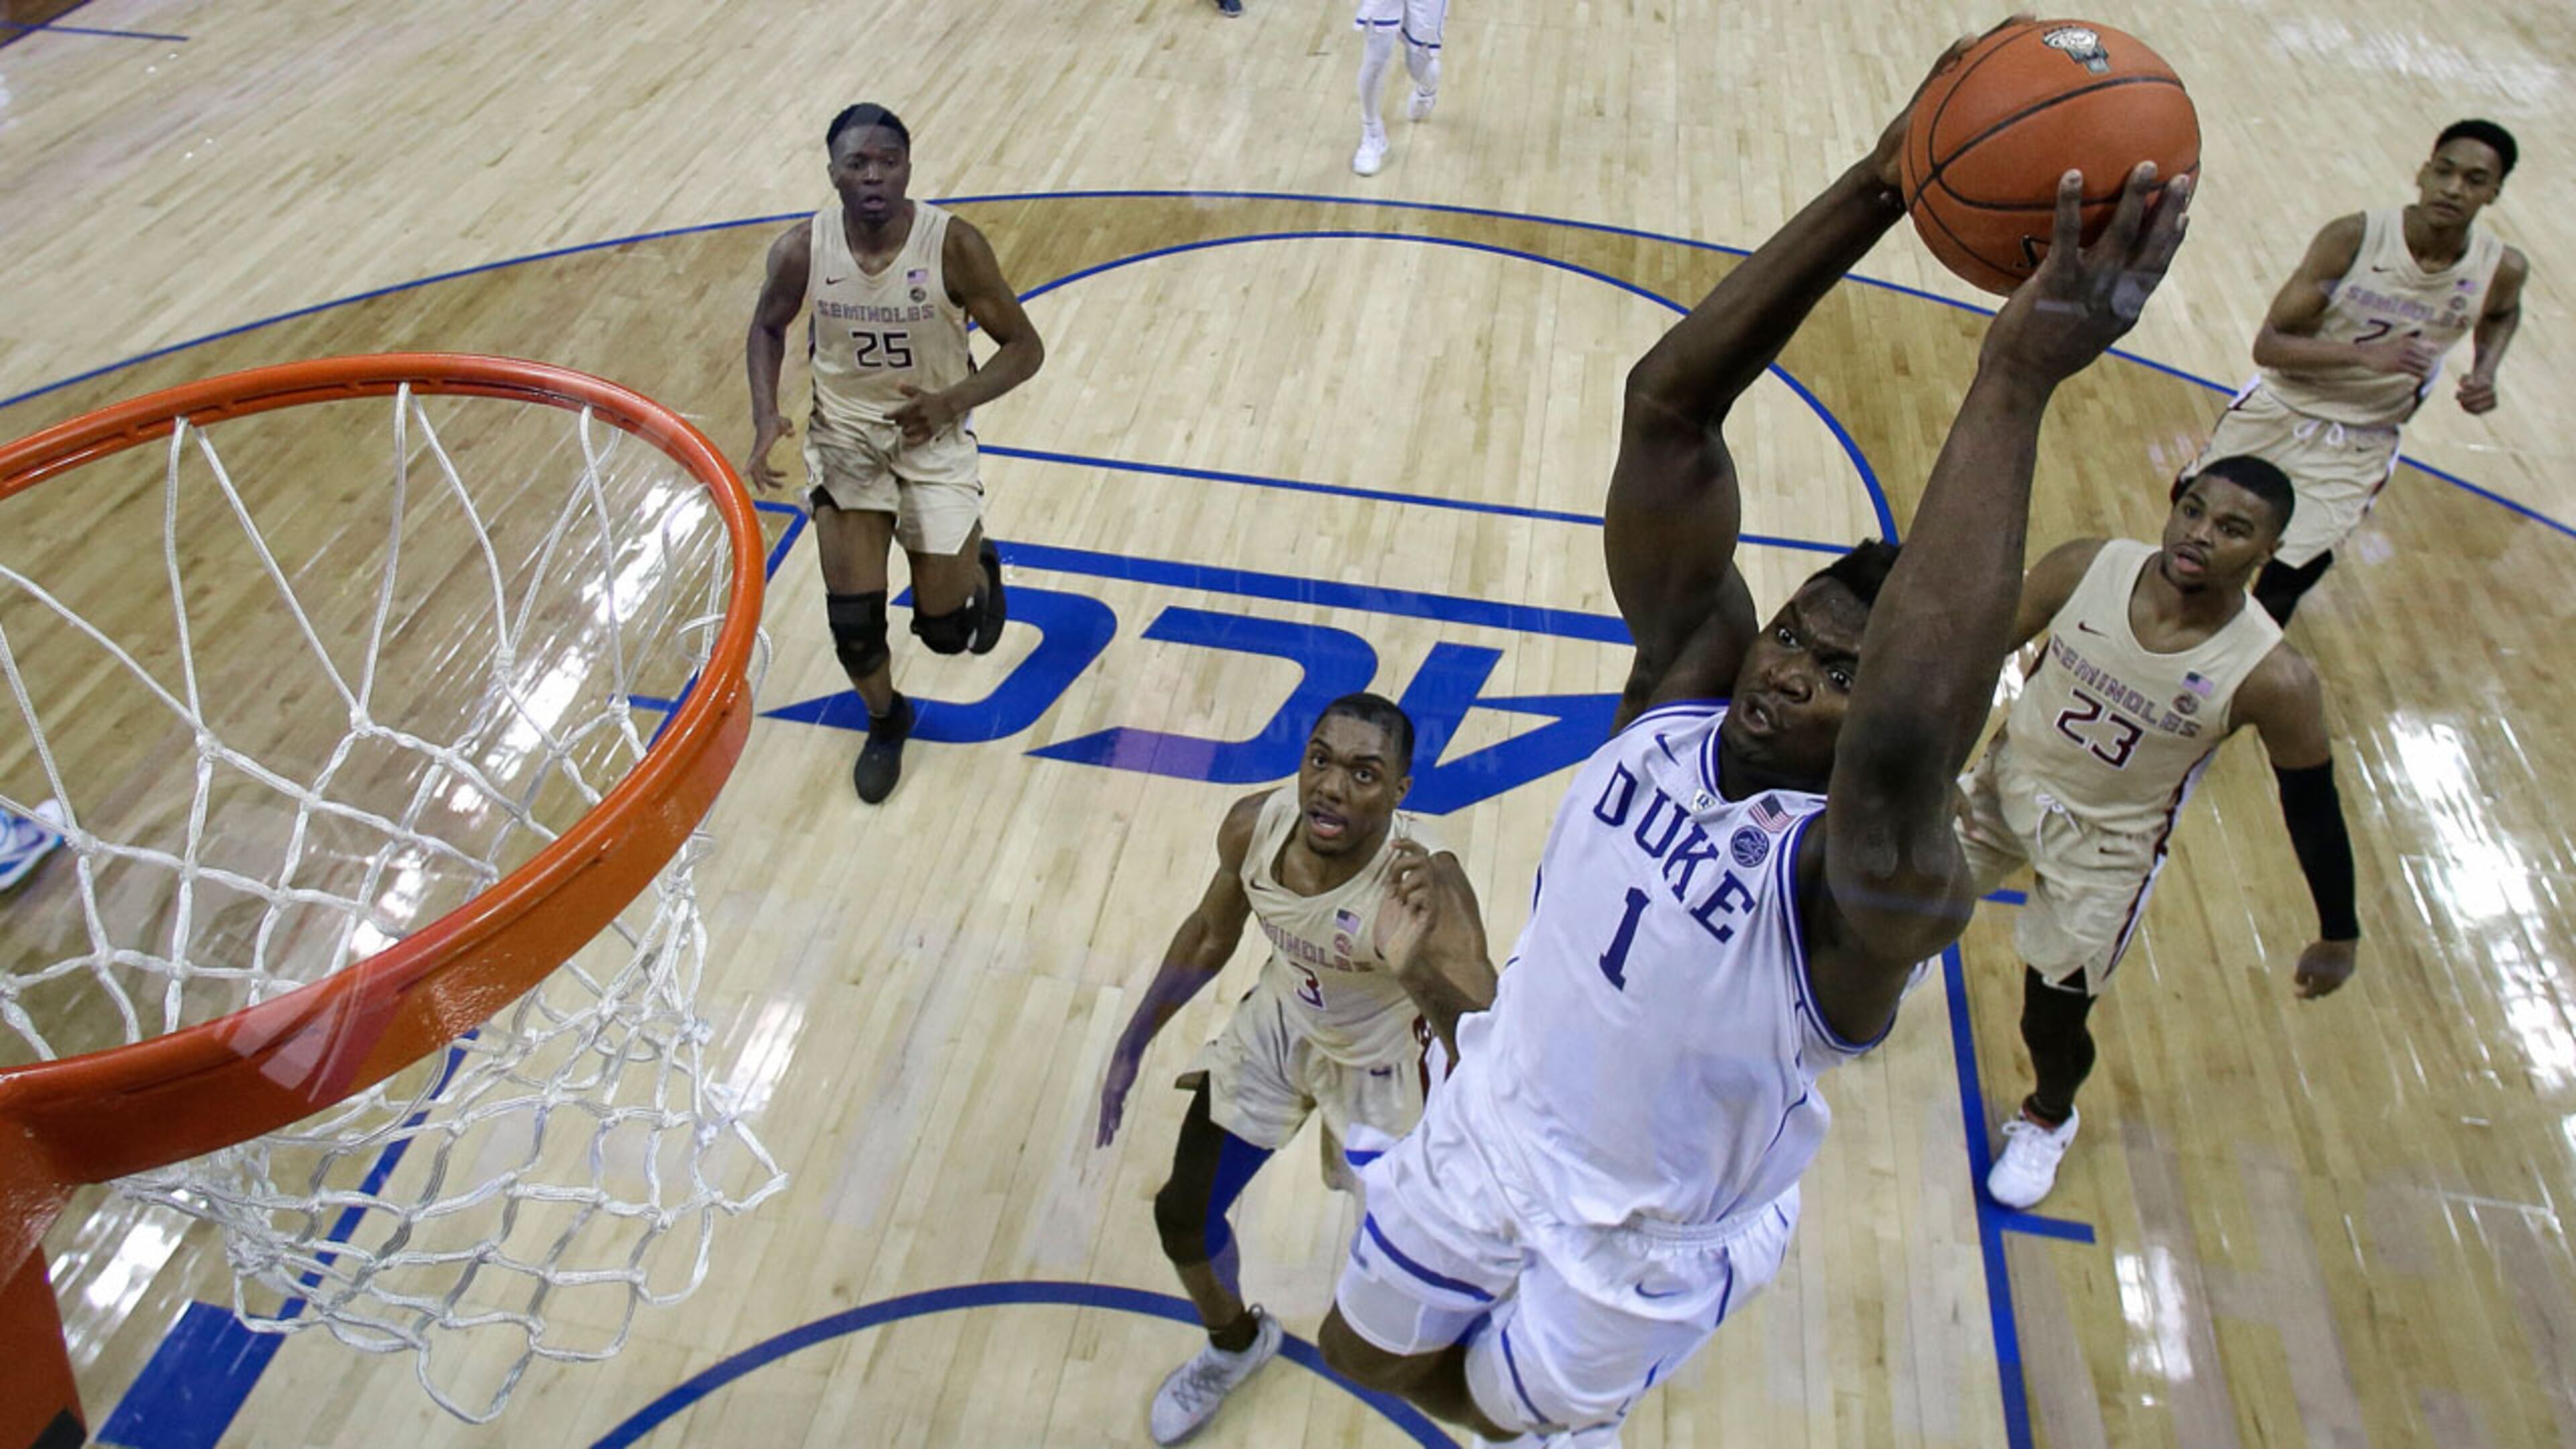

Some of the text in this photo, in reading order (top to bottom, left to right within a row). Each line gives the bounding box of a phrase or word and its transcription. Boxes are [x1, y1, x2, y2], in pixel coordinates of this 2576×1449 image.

[816, 300, 935, 323] SEMINOLES
[851, 331, 913, 368] 25
[2050, 633, 2202, 739] SEMINOLES
[2055, 688, 2145, 769] 23
[1593, 759, 1756, 945] DUKE
[1599, 886, 1651, 992] 1
